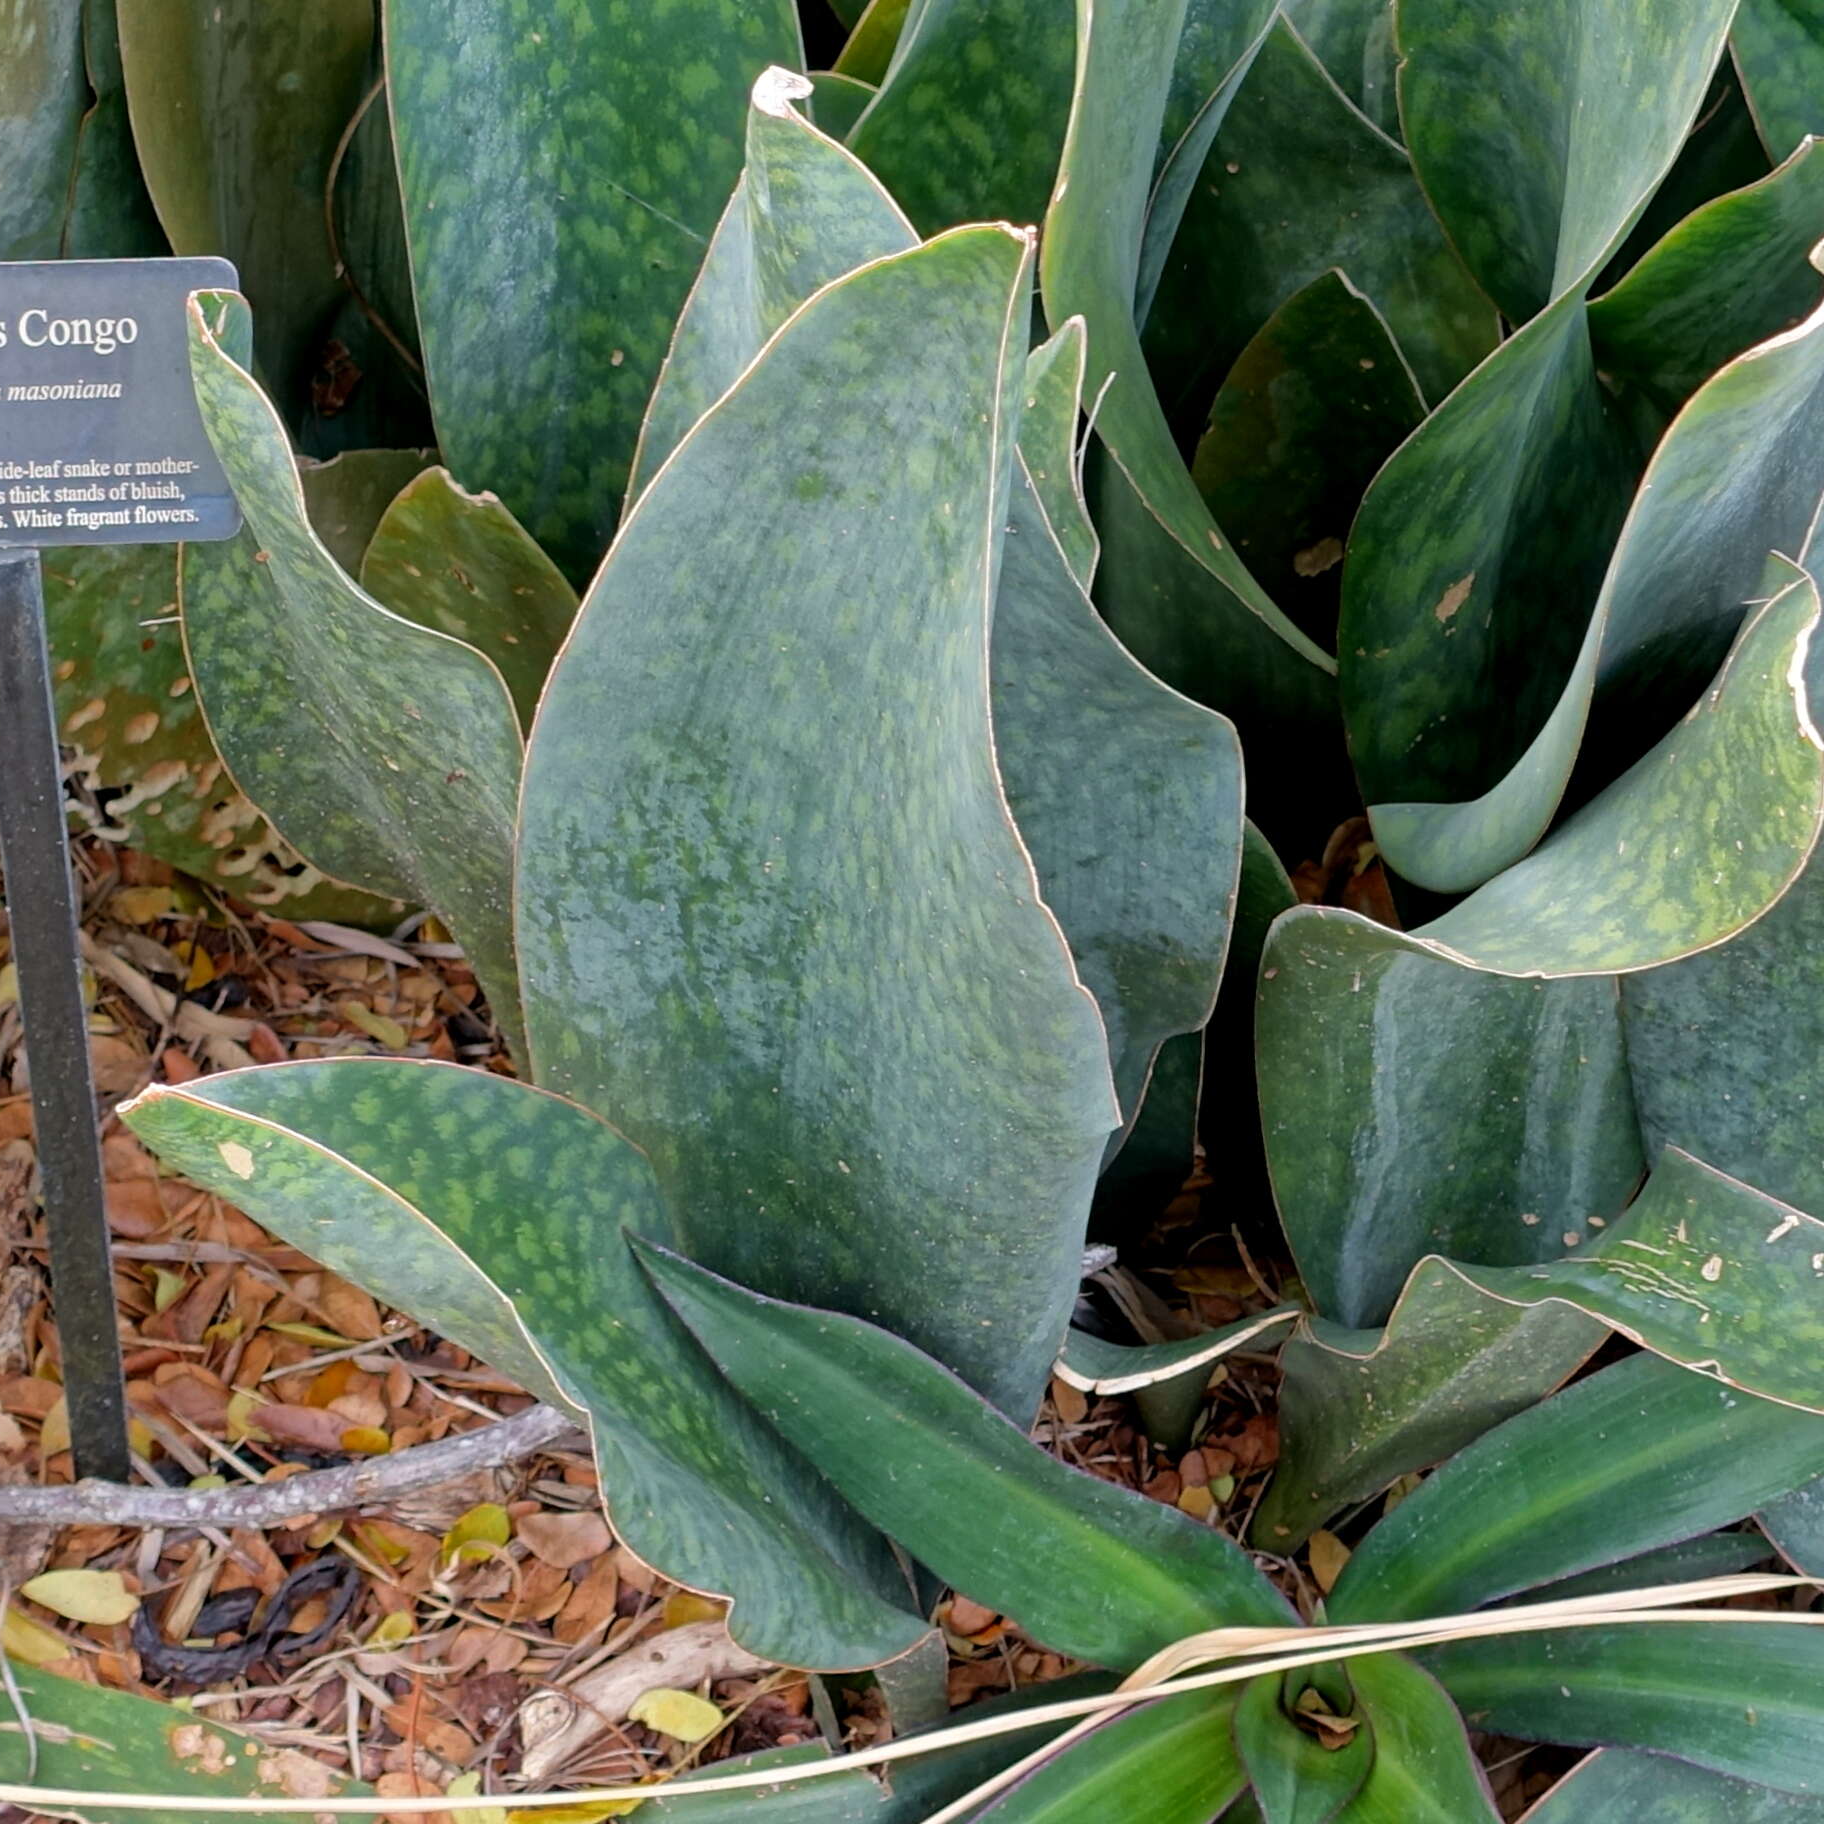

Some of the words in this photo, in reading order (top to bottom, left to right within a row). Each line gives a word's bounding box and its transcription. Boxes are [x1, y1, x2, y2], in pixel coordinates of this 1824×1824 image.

[19, 309, 138, 354] Congo
[7, 381, 122, 401] masoniana
[64, 460, 110, 478] snake
[114, 462, 132, 476] or
[136, 457, 199, 476] mother-
[9, 485, 50, 504] thick
[54, 484, 106, 502] stands
[110, 483, 128, 500] of
[131, 482, 185, 502] bluish,
[13, 509, 63, 528] White
[66, 508, 130, 530] fragrant
[134, 506, 199, 524] flowers.
